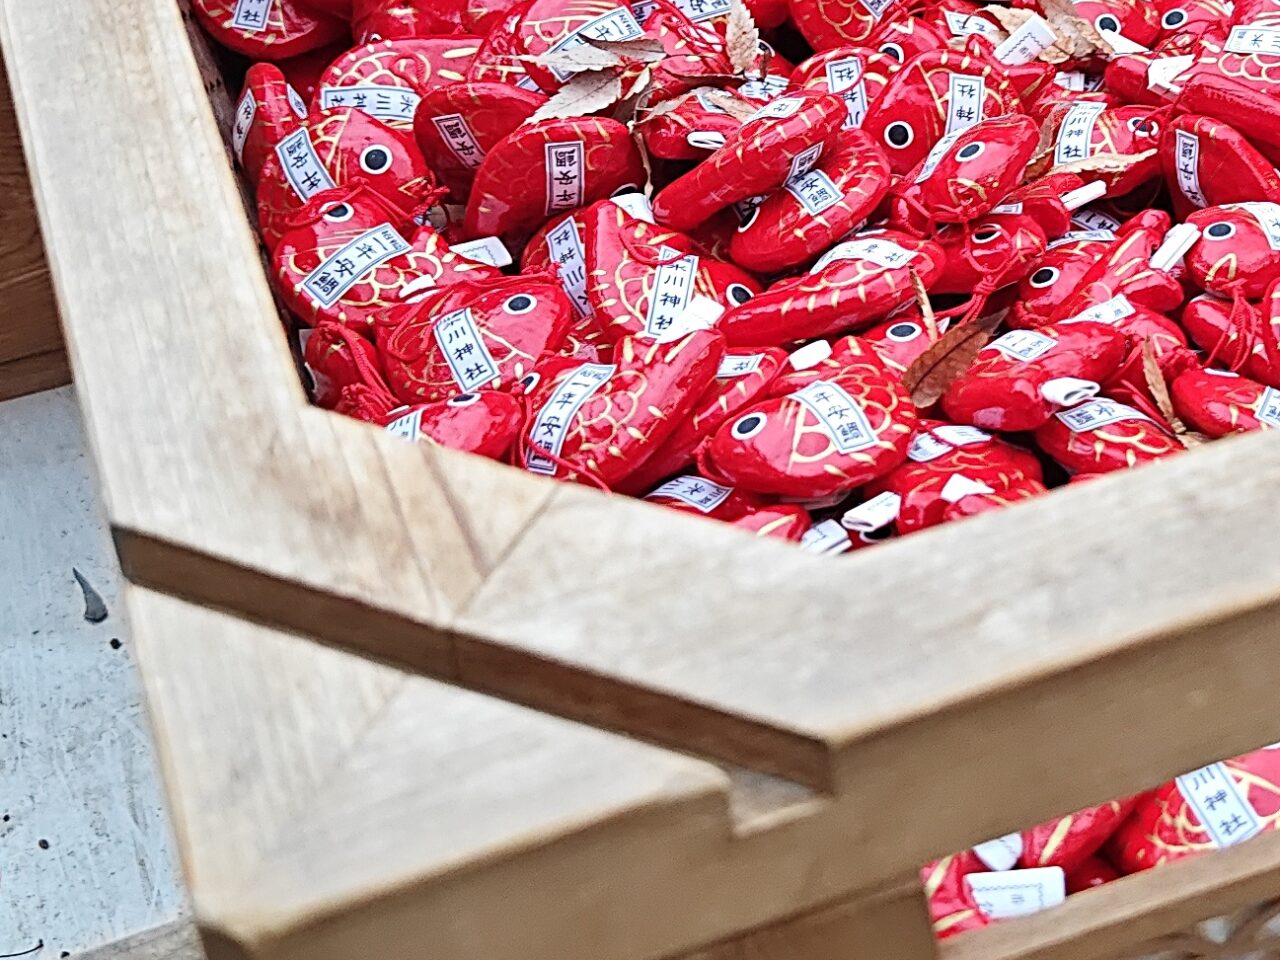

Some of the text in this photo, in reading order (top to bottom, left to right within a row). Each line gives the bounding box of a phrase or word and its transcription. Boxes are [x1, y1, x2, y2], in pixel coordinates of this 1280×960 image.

[314, 234, 389, 297] 一年安鯛
[1193, 768, 1247, 837] 川神社
